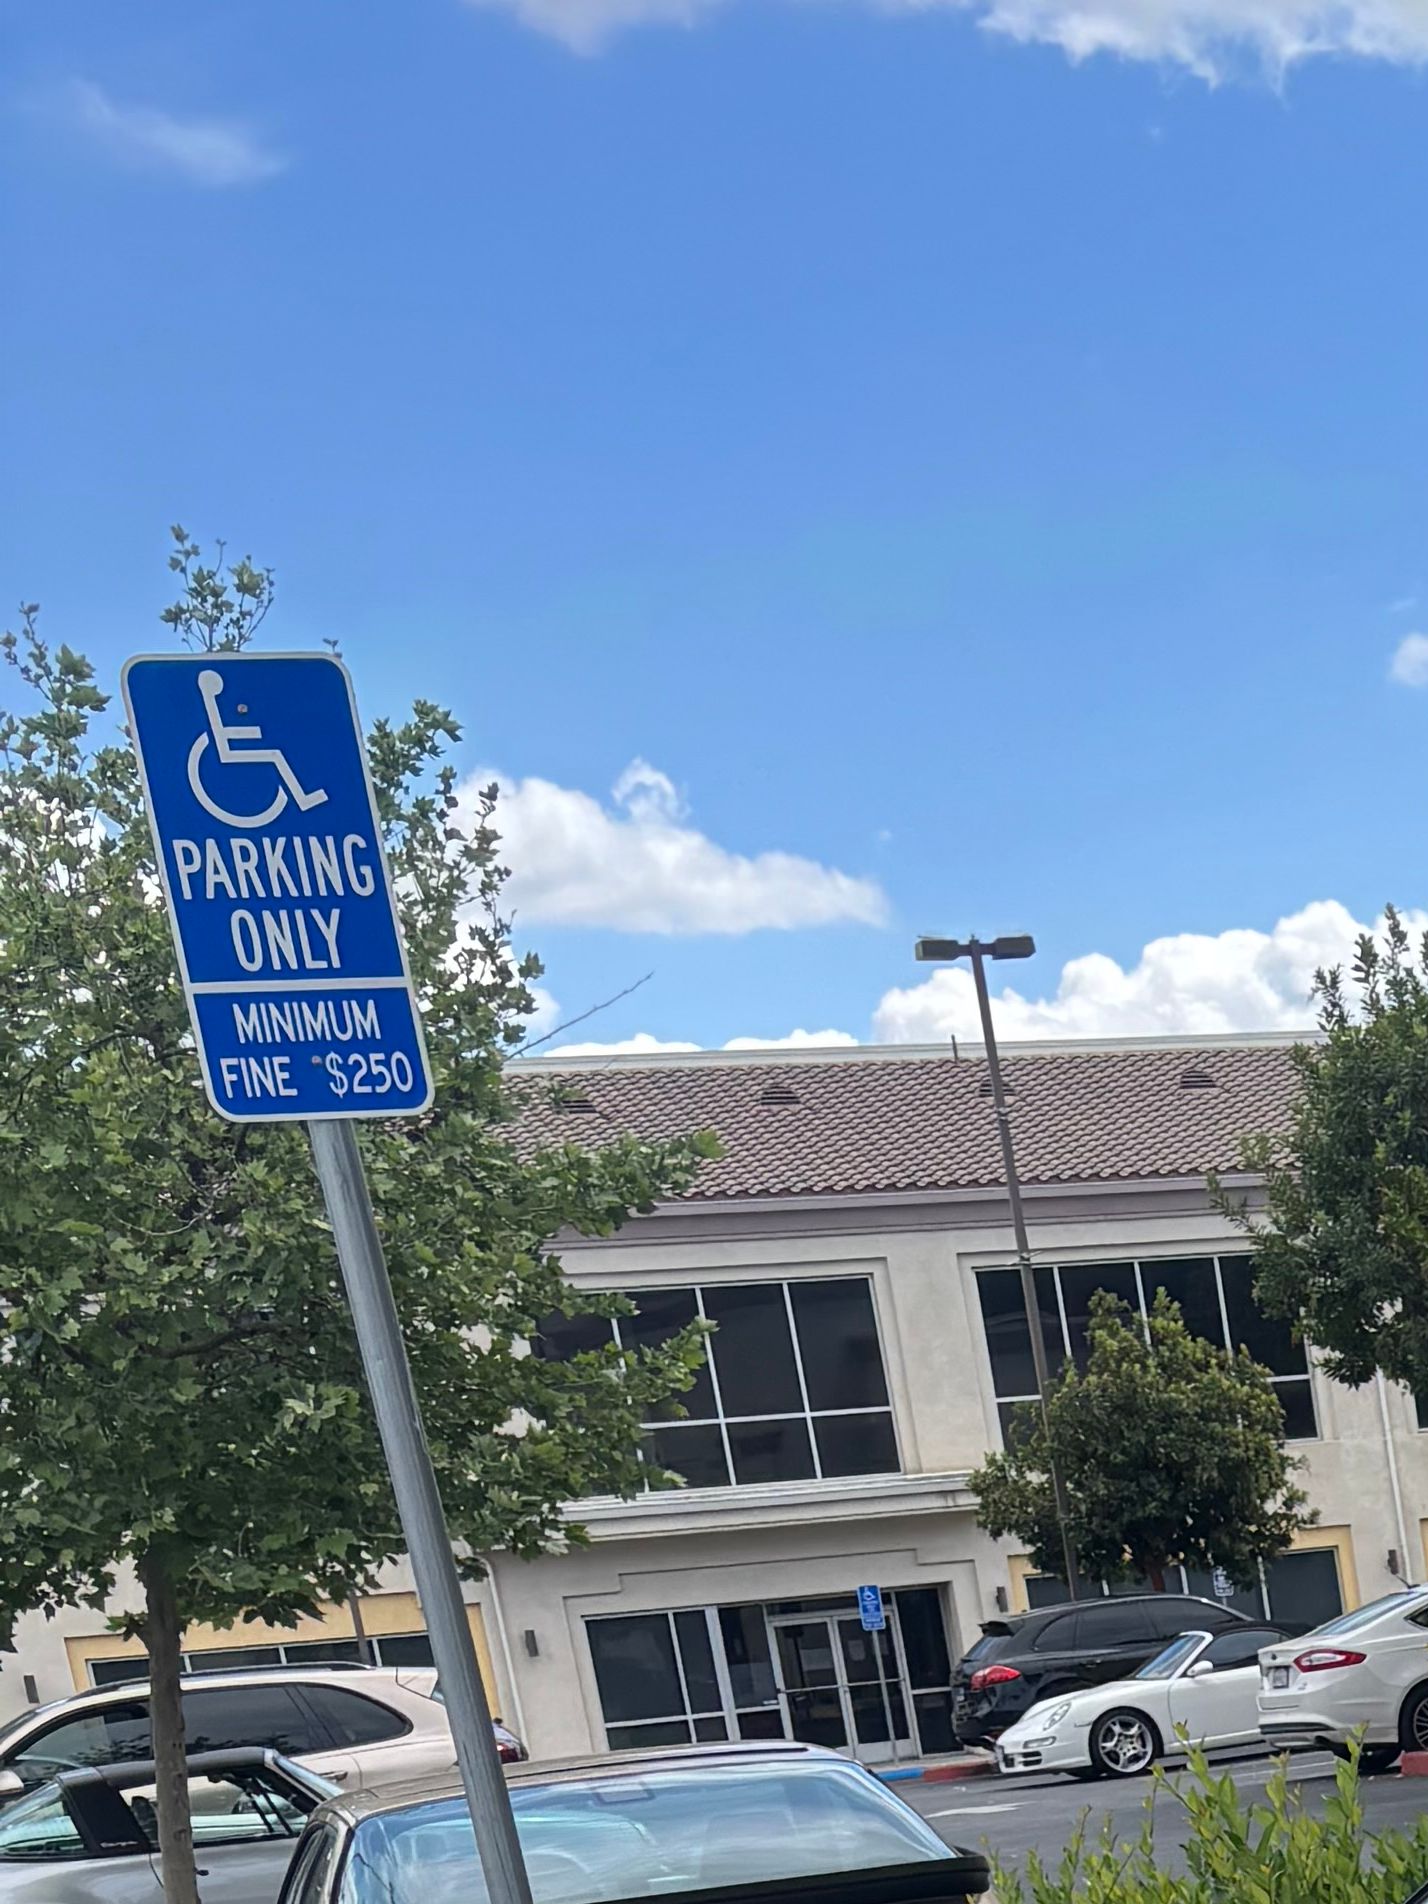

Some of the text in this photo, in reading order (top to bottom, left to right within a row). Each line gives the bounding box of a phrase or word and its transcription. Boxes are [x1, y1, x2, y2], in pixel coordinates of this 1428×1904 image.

[172, 832, 376, 900] PARKING
[230, 907, 342, 972] ONLY
[232, 999, 382, 1044] MINIMUM
[219, 1050, 414, 1099] FINE $250
